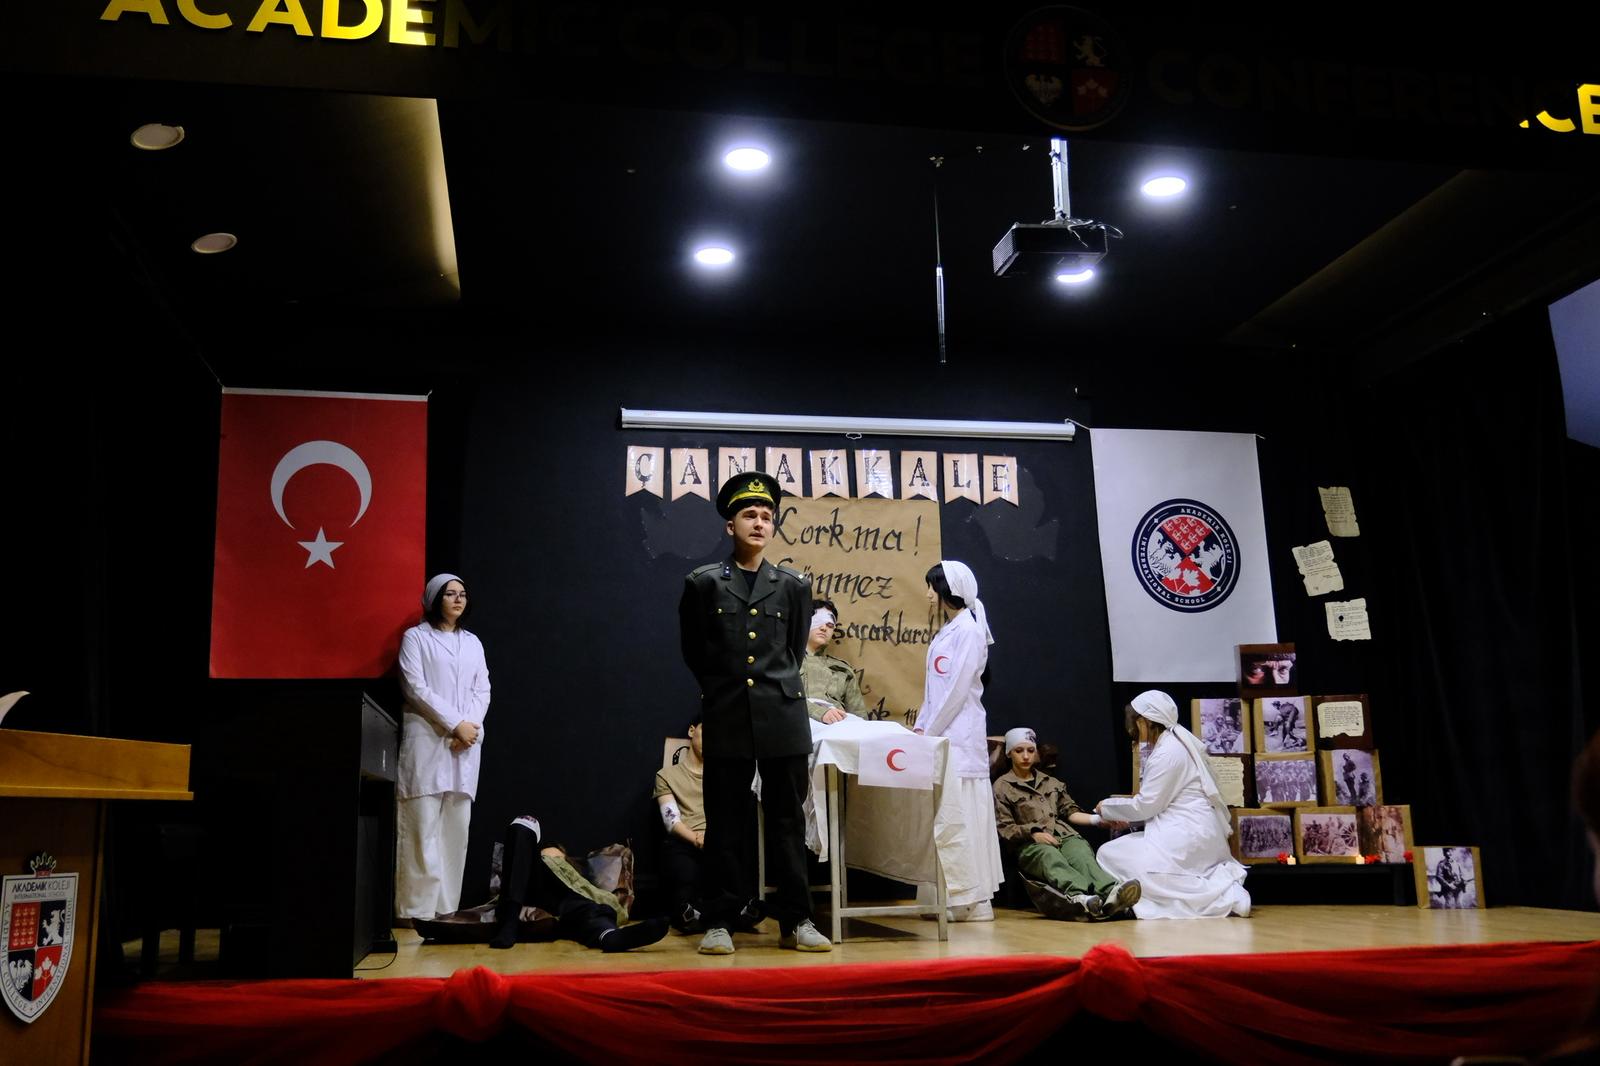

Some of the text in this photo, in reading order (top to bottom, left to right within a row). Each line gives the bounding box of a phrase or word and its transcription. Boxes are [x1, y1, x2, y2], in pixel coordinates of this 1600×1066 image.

[634, 452, 1010, 492] ÇANAKKALE
[777, 557, 893, 604] önmez
[1139, 536, 1206, 605] INTERNATIONAL SCHOOL
[831, 609, 939, 657] şafaklard
